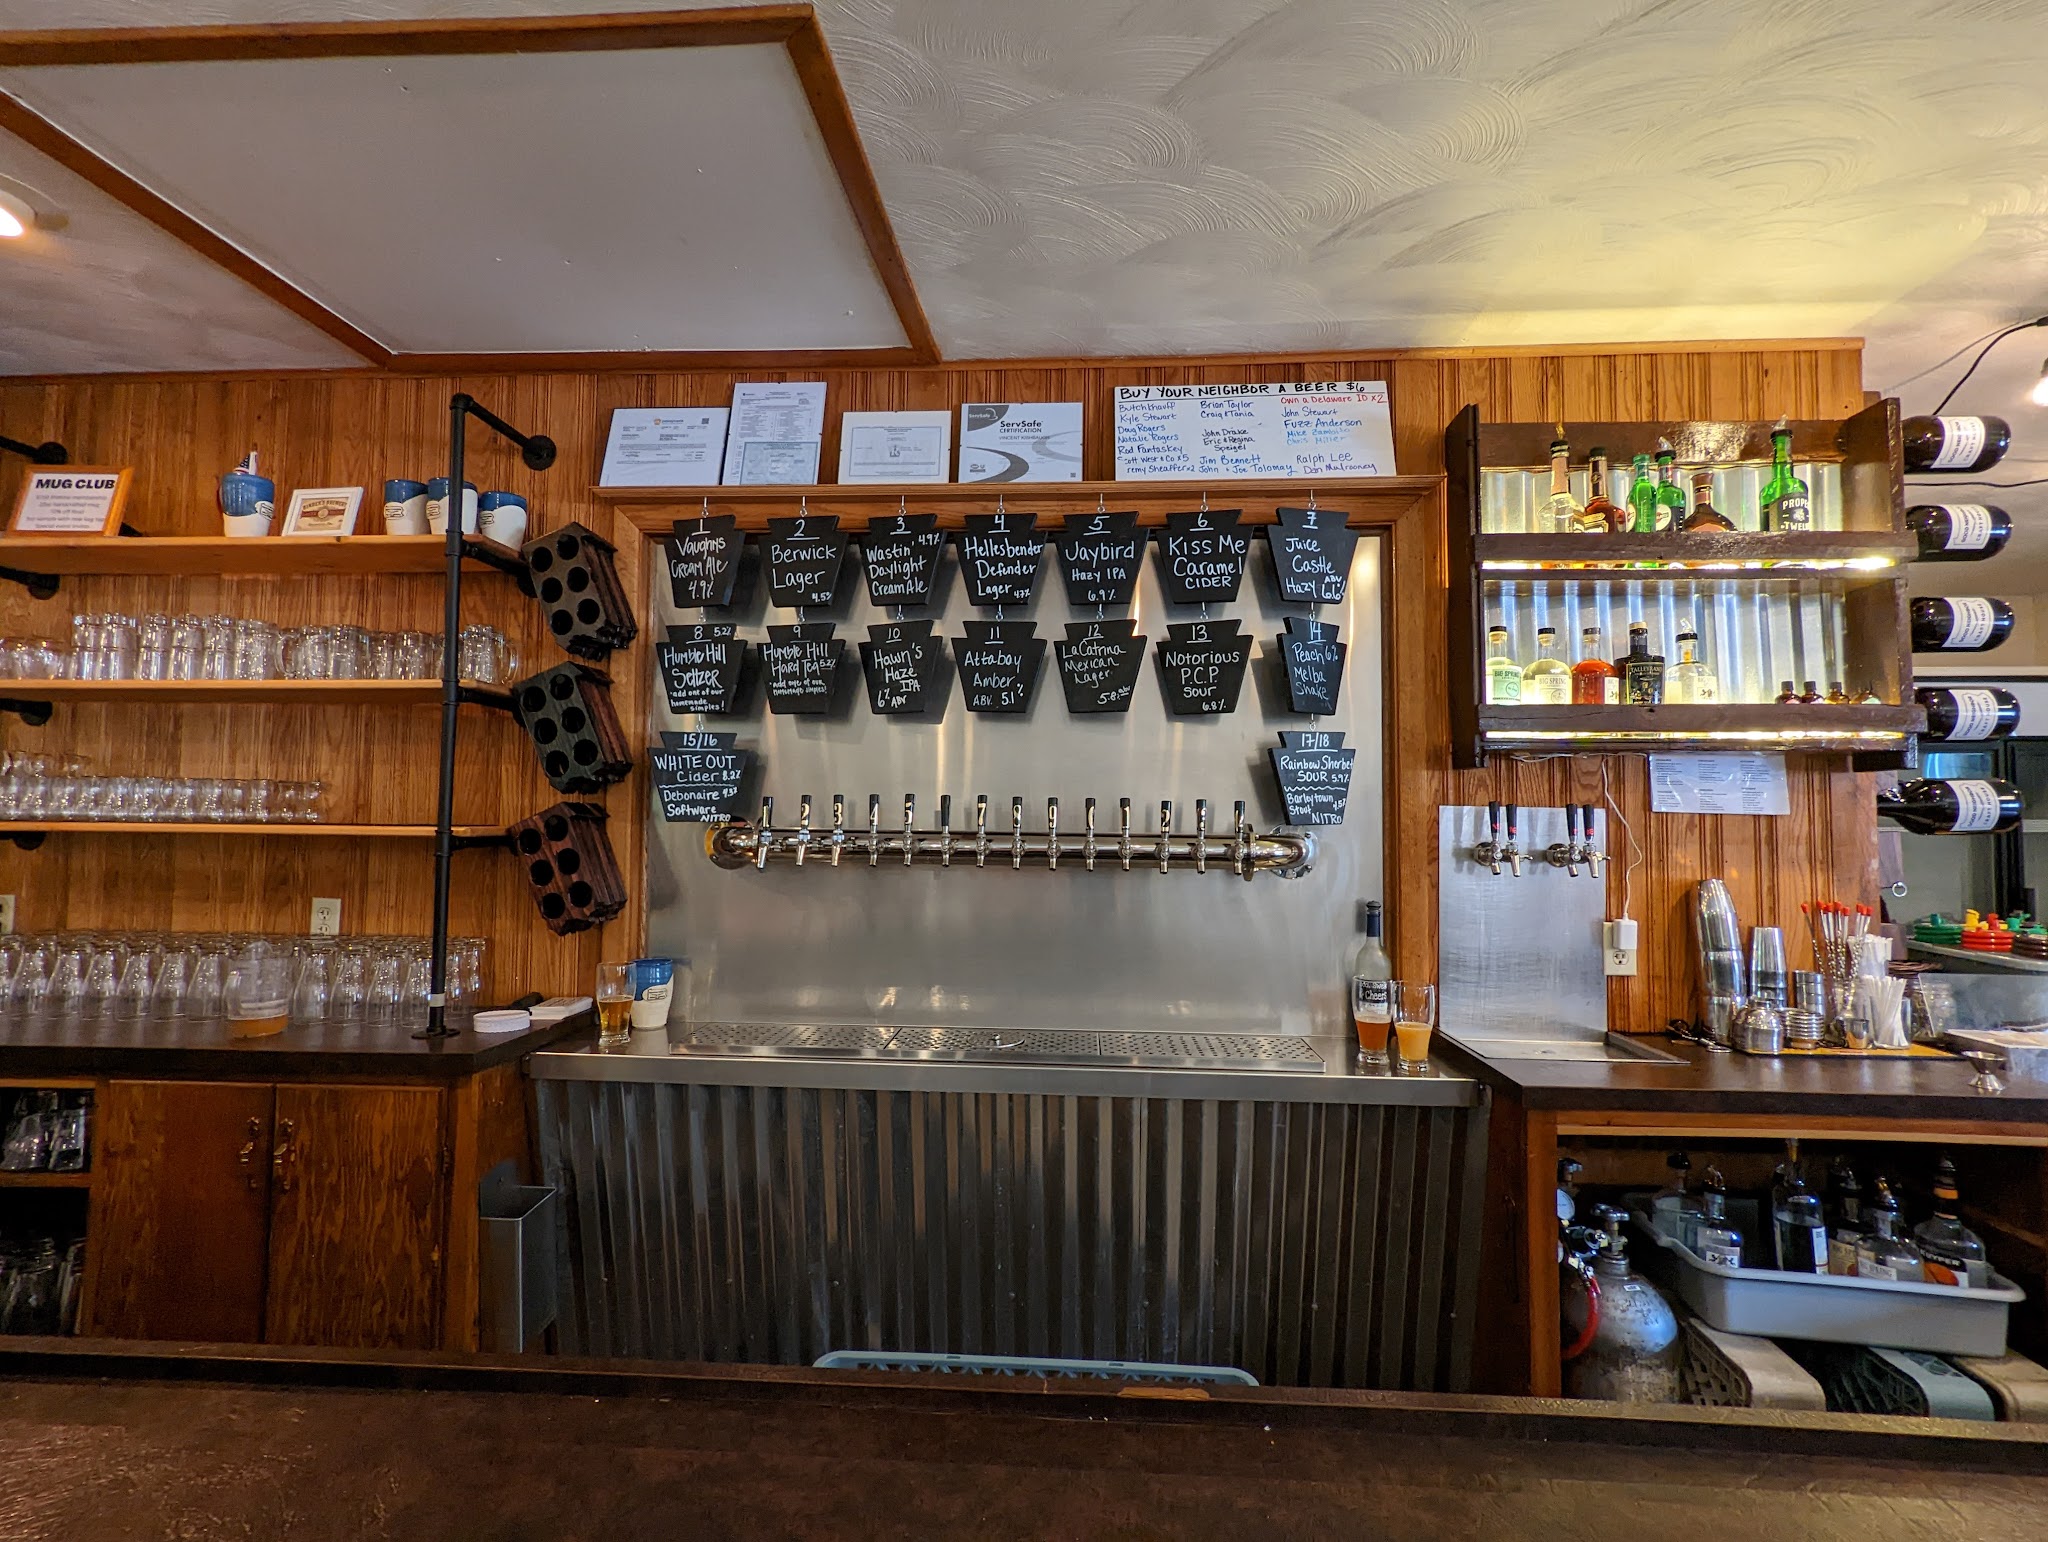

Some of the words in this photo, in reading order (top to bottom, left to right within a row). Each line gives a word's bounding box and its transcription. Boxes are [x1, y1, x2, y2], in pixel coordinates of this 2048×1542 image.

[1120, 387, 1150, 400] BUY
[1156, 386, 1194, 398] YOUR
[1198, 384, 1270, 396] NEIGHBOR
[1278, 384, 1286, 393] A
[1295, 383, 1338, 392] BEER
[1347, 382, 1364, 392] $6
[1200, 400, 1224, 409] Brian
[1224, 400, 1254, 411] Taylor
[1280, 396, 1299, 404] Own
[1312, 395, 1352, 404] Delaware
[1120, 414, 1140, 424] Kyle
[1143, 412, 1177, 421] Stewart
[1281, 407, 1299, 417] John
[1302, 406, 1338, 416] Stewart
[1000, 420, 1042, 428] ServSafe
[1284, 420, 1312, 429] Fuzz
[1315, 418, 1362, 428] Anderson
[1202, 429, 1221, 438] John
[1200, 456, 1216, 464] Jim
[1296, 454, 1324, 467] Ralph
[1331, 452, 1353, 462] Lee
[35, 479, 72, 489] MUG
[75, 479, 115, 489] CLUB
[896, 517, 905, 532] 3
[994, 515, 1005, 530] 4
[1088, 516, 1110, 531] 5
[1198, 513, 1208, 528] 6
[1306, 512, 1317, 526] 7
[794, 520, 806, 537] 2
[918, 532, 941, 546] 4.9%
[1169, 536, 1212, 556] Kiss
[1219, 534, 1246, 554] Me
[1286, 538, 1320, 552] Juice
[772, 544, 836, 564] Berwick
[866, 540, 914, 563] Wastin'
[964, 536, 1044, 560] Hellesbender
[1065, 541, 1134, 568] Jaybird
[706, 557, 728, 576] Ale
[868, 556, 927, 580] Daylight
[976, 560, 1036, 578] Defender
[1174, 556, 1242, 578] Caramel
[1292, 554, 1335, 574] Castle
[772, 568, 826, 593] Lager
[1072, 568, 1100, 582] Hazy
[1106, 567, 1126, 580] IPA
[1324, 576, 1342, 584] ABV
[688, 579, 714, 600] 4.9%
[872, 581, 906, 596] Cream
[906, 578, 928, 595] Ale
[977, 580, 1012, 600] Lager
[1186, 576, 1232, 590] CIDER
[1286, 577, 1317, 598] Hazy
[1088, 589, 1116, 602] 6.9%
[694, 626, 702, 640] 8
[714, 627, 732, 637] 5.2%
[794, 626, 801, 638] 9
[888, 628, 900, 640] 10
[990, 626, 1000, 640] 11
[1088, 624, 1102, 638] 12
[1192, 624, 1208, 641] 13
[1310, 621, 1322, 640] 14
[664, 647, 706, 668] Humble
[706, 644, 726, 664] Hill
[764, 644, 802, 662] Humble
[806, 643, 828, 660] Hill
[874, 642, 922, 669] Hawn's
[1166, 652, 1240, 668] Notorious
[1292, 642, 1324, 664] Peach
[1325, 645, 1338, 662] 6%
[772, 660, 800, 680] Hard
[802, 659, 820, 678] Tea
[820, 659, 836, 669] 5.2%
[964, 650, 1022, 674] Attaboy
[1064, 656, 1119, 673] Mexican
[672, 668, 722, 688] Seltzer
[884, 666, 918, 683] Haze
[973, 674, 1016, 688] Amber
[1181, 666, 1220, 684] P.C.P.
[1294, 665, 1326, 683] Melba
[672, 689, 686, 697] add
[702, 687, 710, 696] of
[900, 680, 920, 692] IPA
[1296, 682, 1328, 700] Shake
[670, 698, 708, 707] homemade
[877, 688, 890, 708] 6%
[891, 694, 907, 708] ABV
[1001, 684, 1024, 706] 5.1%
[1202, 699, 1226, 711] 6.8%
[684, 733, 718, 749] 15/16
[1302, 732, 1330, 750] 17/18
[654, 754, 702, 771] WHITE
[706, 754, 736, 770] OUT
[1280, 756, 1320, 770] Rainbow
[1320, 755, 1354, 770] Sherbet
[676, 771, 720, 782] Cider
[722, 770, 741, 780] 8.2%
[1297, 770, 1328, 782] SOUR
[1332, 774, 1350, 782] 5.9%
[664, 790, 720, 802] Debonaire
[722, 786, 738, 798] 4.3%
[1286, 793, 1334, 806] Barleytown
[666, 804, 716, 816] Software
[700, 814, 732, 822] NITRO
[801, 803, 810, 826] 2
[834, 803, 842, 824] 3
[870, 803, 878, 825] 4
[978, 803, 986, 824] 7
[1014, 805, 1021, 828] 8
[1050, 806, 1057, 828] 9
[1289, 806, 1312, 815] Stout
[1312, 812, 1342, 824] NITRO
